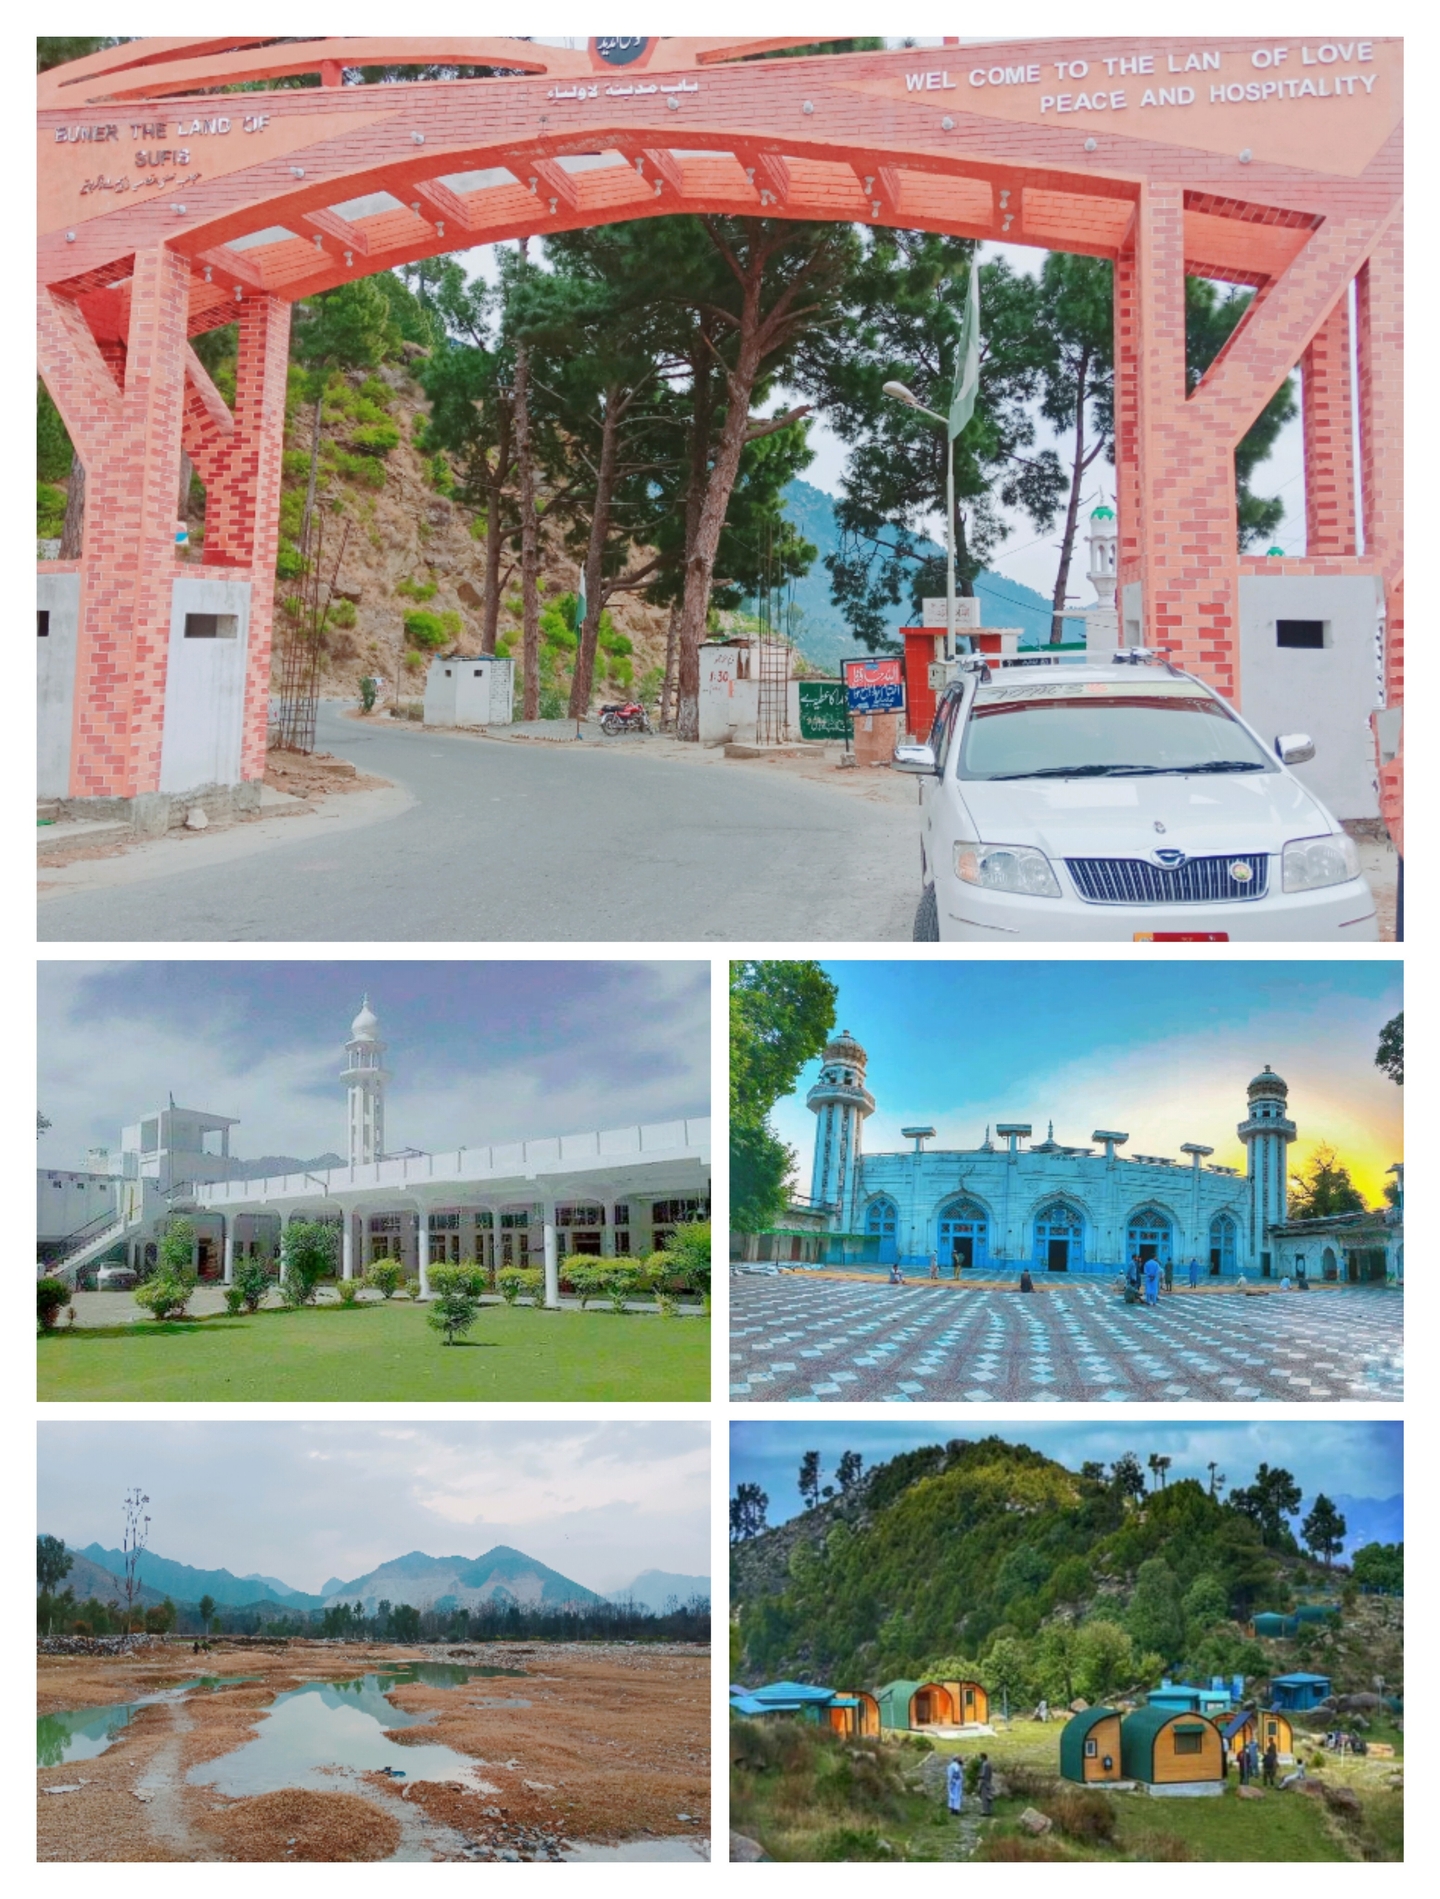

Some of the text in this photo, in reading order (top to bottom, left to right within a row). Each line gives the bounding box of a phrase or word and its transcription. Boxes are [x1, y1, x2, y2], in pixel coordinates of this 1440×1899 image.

[905, 42, 1374, 92] WEL COME TO THE LAN OF LOVE
[1040, 74, 1378, 115] PEACE AND HOSPITALITY
[54, 115, 271, 143] BUNER THE LAND OF
[135, 147, 191, 167] SUFIS
